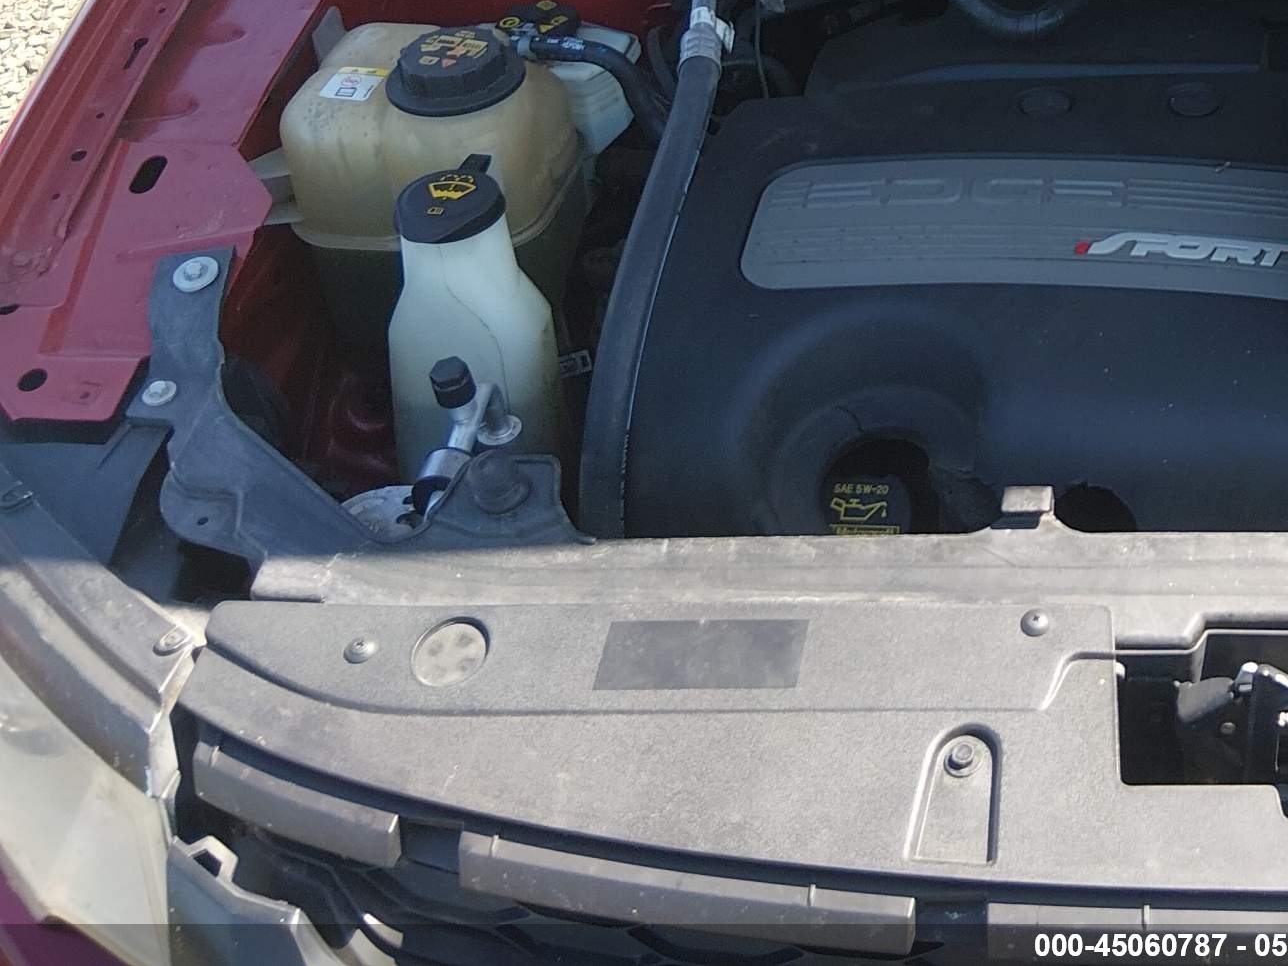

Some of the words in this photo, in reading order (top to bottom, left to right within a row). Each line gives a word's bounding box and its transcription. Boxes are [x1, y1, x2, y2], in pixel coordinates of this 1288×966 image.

[803, 178, 1125, 208] EDGE
[834, 483, 853, 493] SAE
[855, 483, 889, 495] 5W-20
